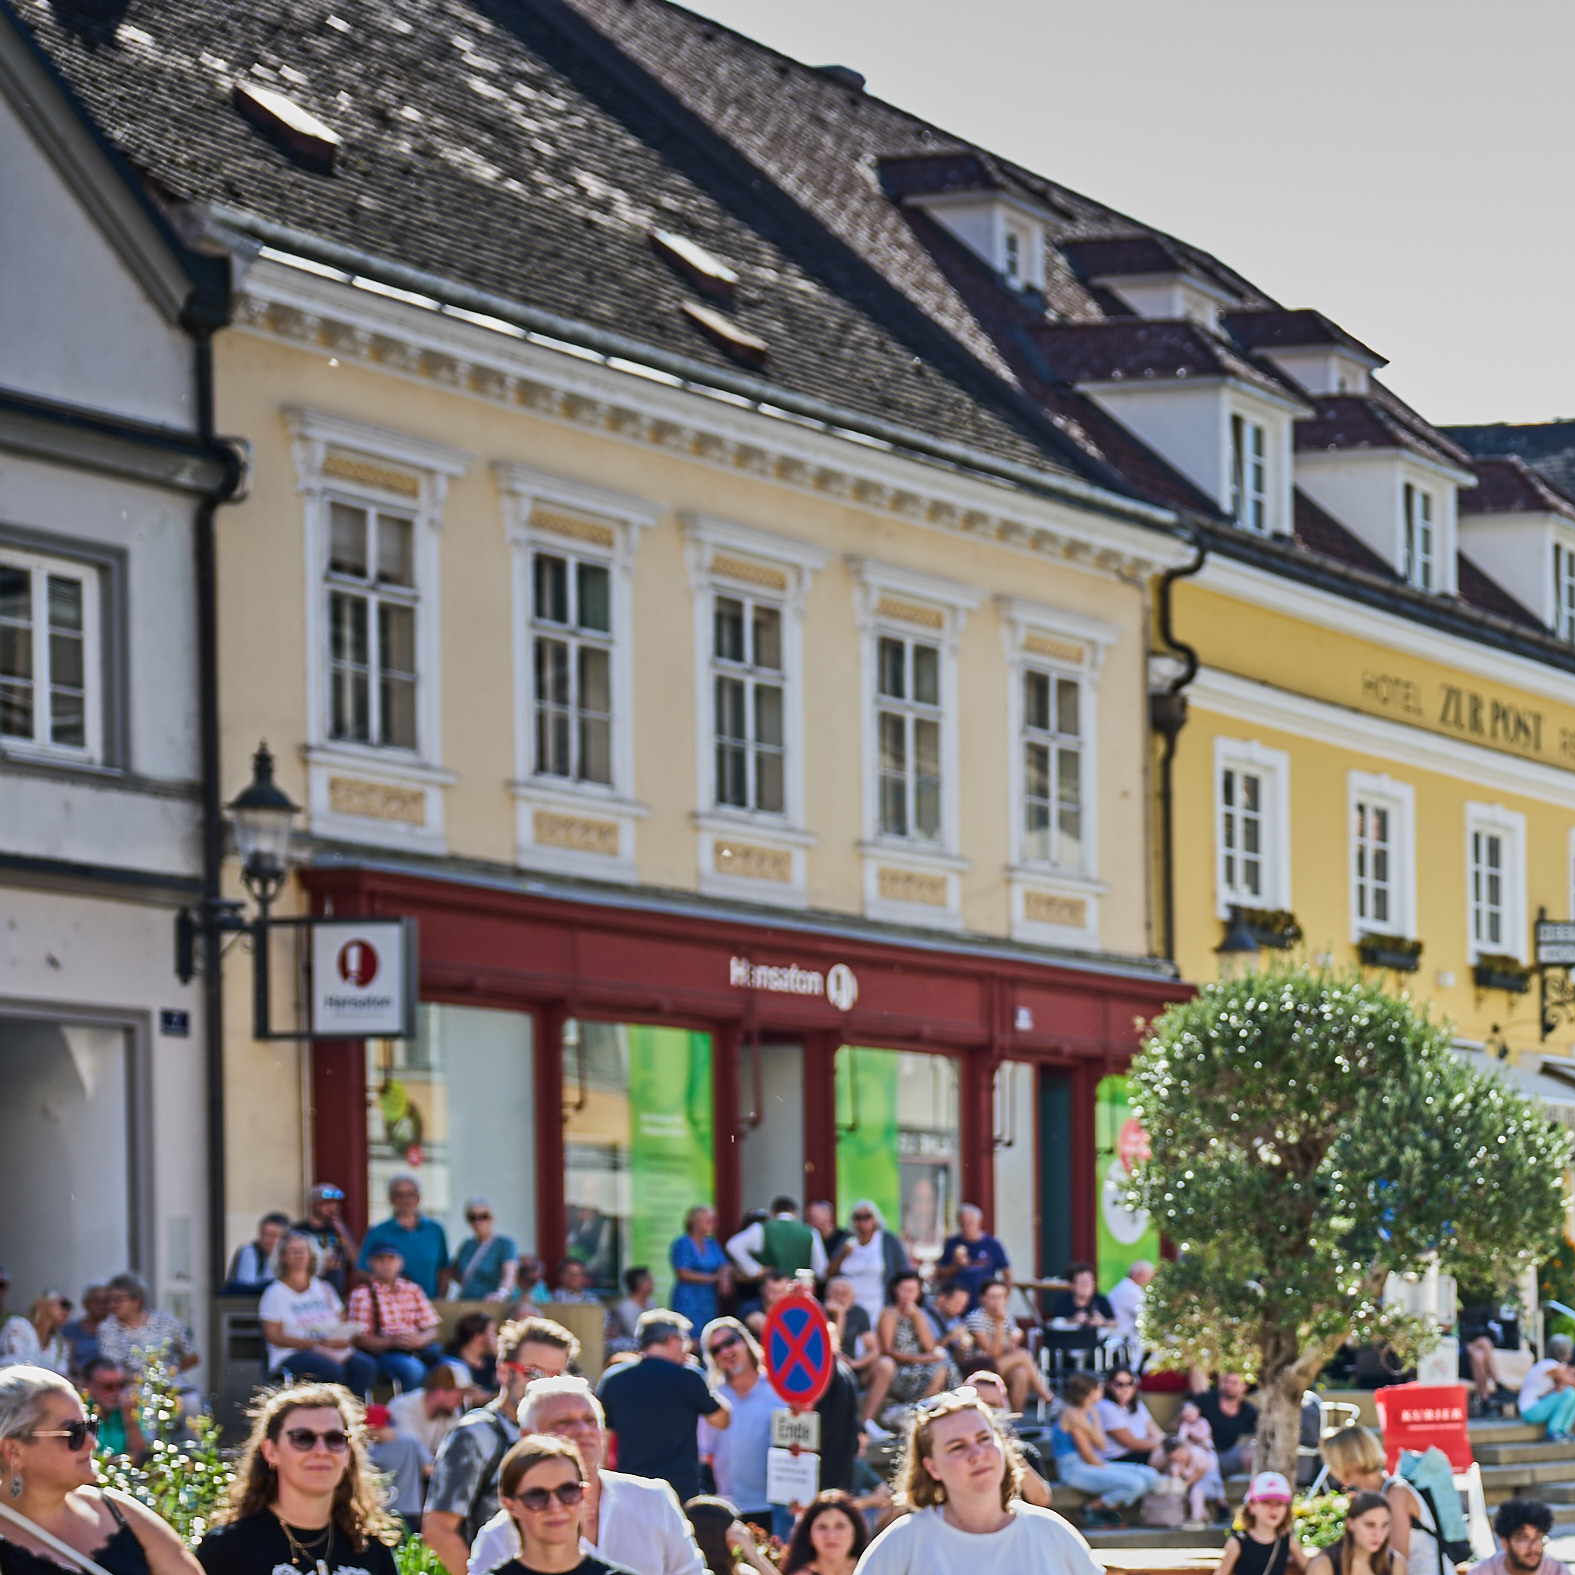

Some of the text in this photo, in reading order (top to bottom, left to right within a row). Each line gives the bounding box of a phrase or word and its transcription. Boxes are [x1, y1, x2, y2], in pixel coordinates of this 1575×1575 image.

[1440, 683, 1485, 736] ZUR
[1489, 698, 1544, 751] POST
[778, 1416, 810, 1440] Ende
